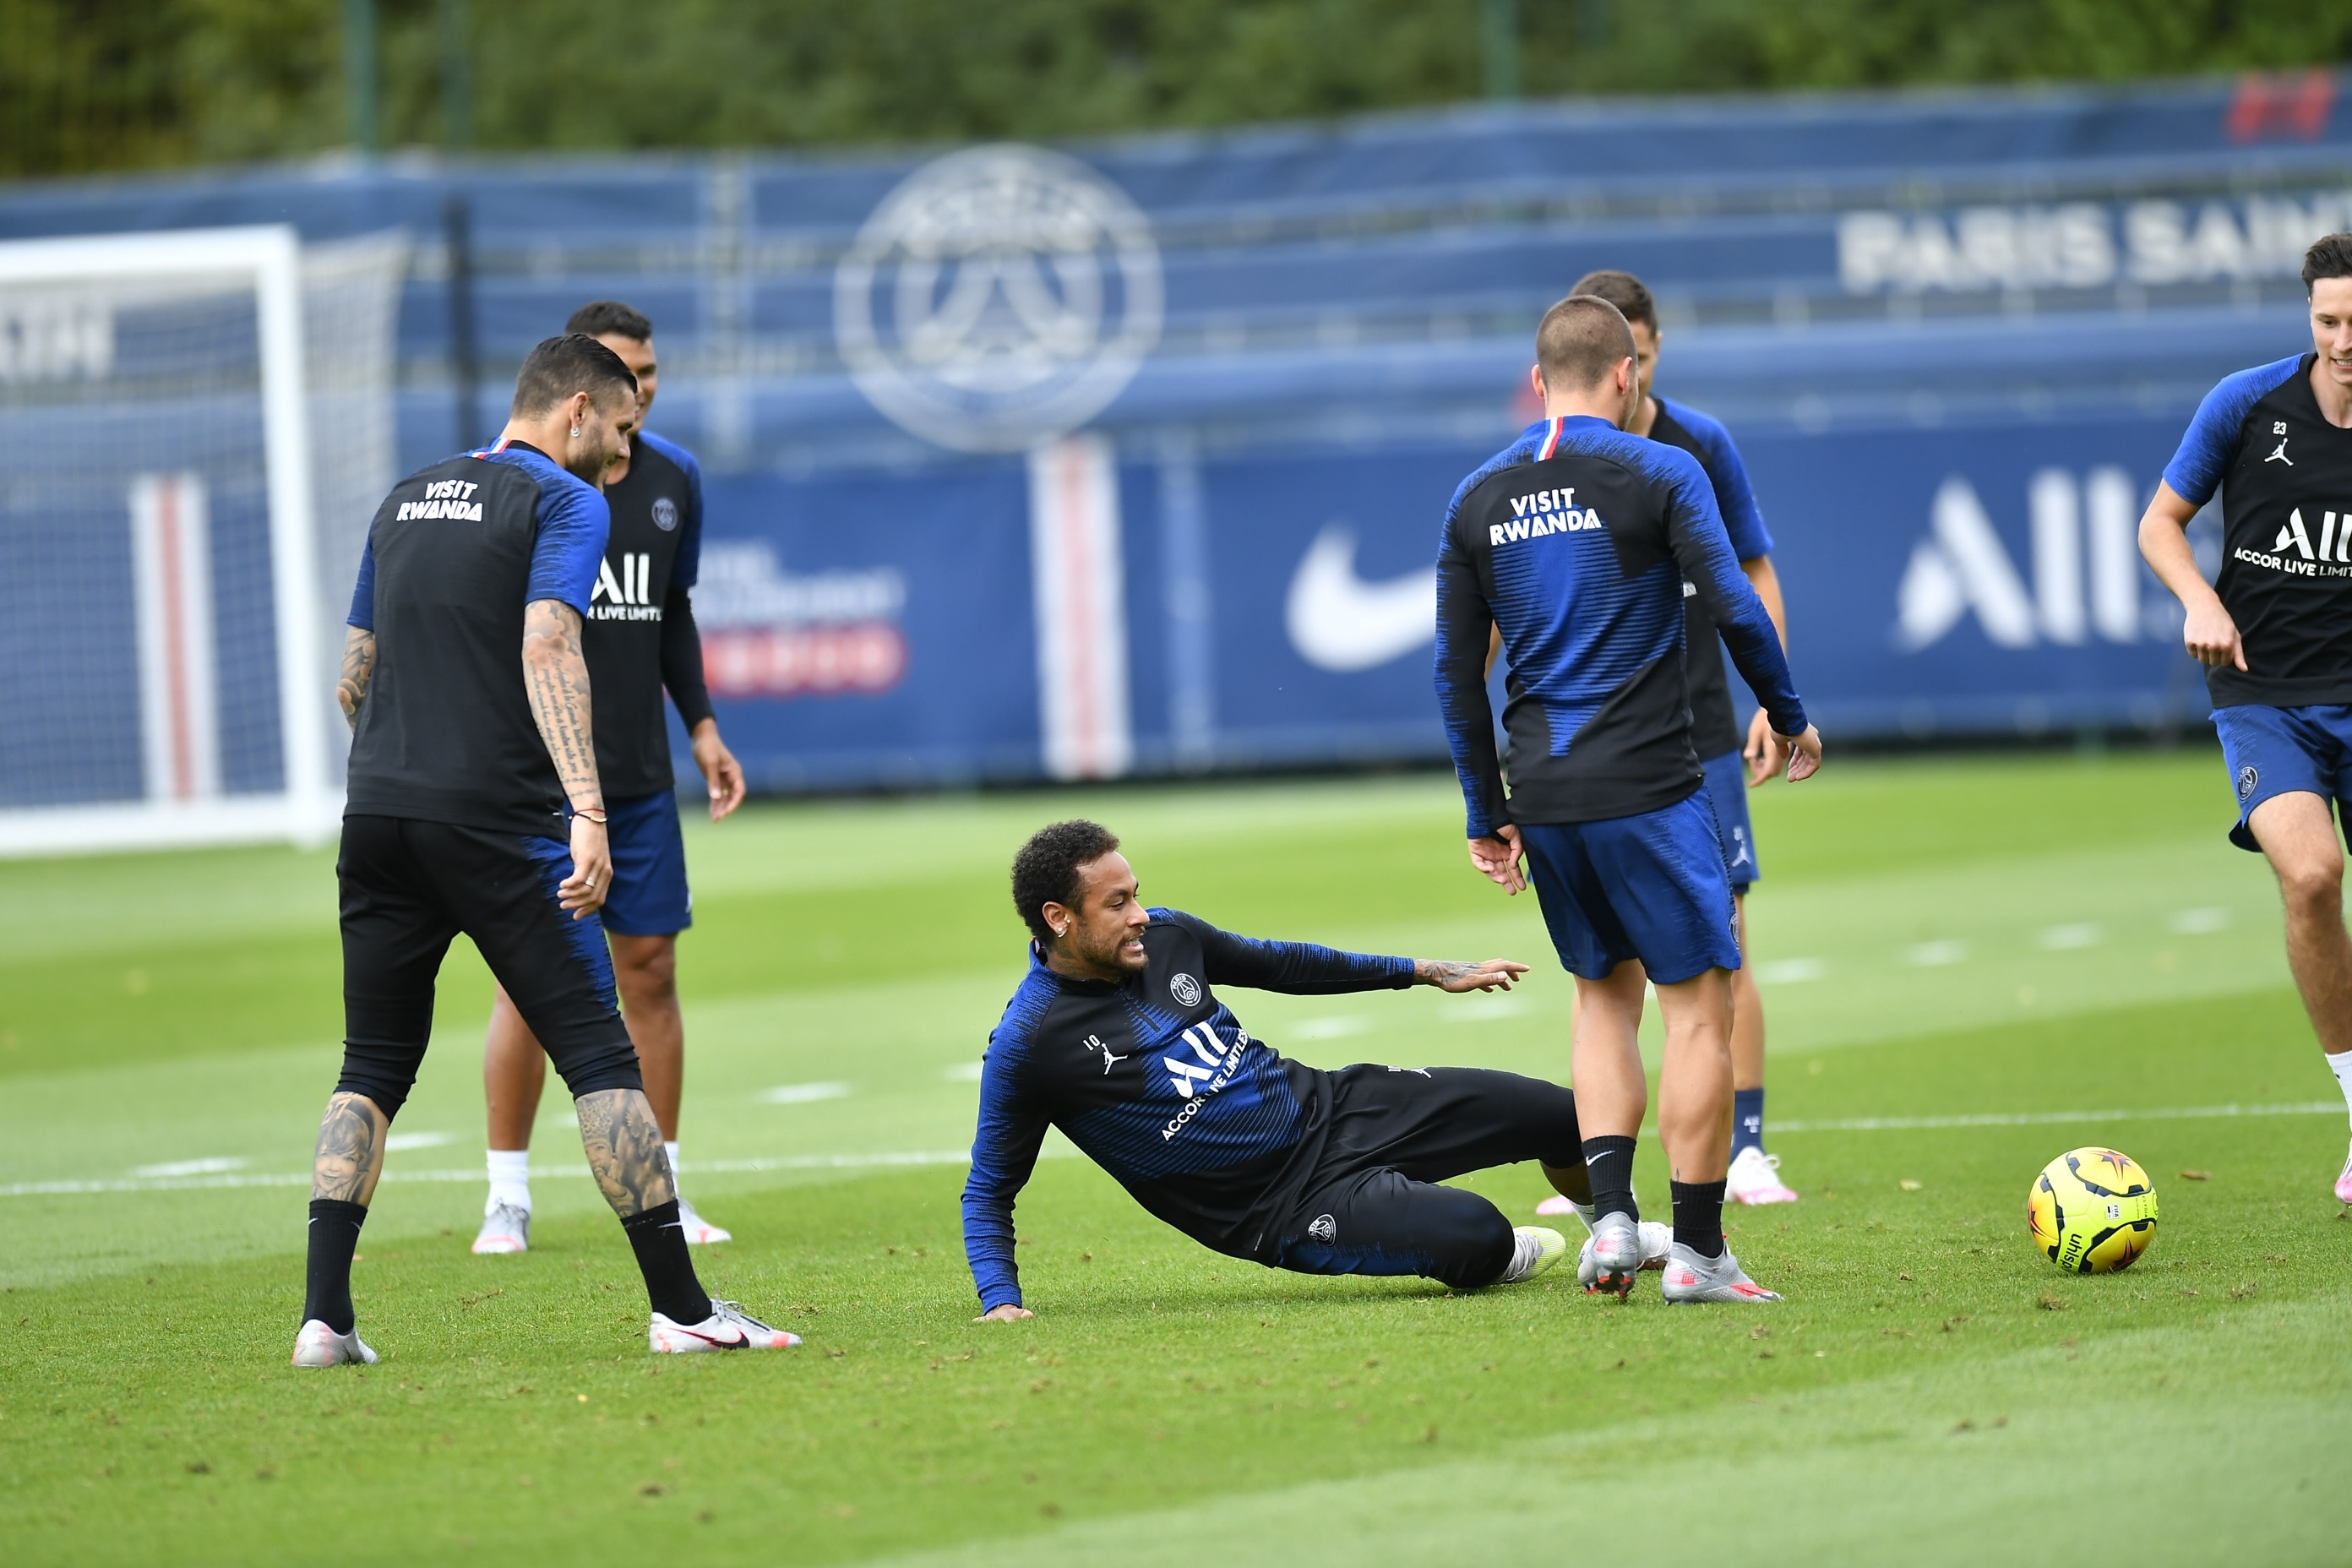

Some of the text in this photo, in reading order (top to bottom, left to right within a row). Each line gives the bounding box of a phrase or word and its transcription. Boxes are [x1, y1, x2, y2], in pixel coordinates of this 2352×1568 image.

[1839, 207, 2114, 295] PARIS
[2273, 421, 2287, 435] 23
[425, 479, 478, 500] VISIT
[1510, 487, 1575, 517] VISIT
[395, 499, 483, 522] RWANDA
[1489, 508, 1602, 546] RWANDA
[2234, 547, 2282, 571] ACCOR
[2284, 558, 2317, 576] LIVE
[1082, 1034, 1101, 1051] 10
[1162, 1096, 1206, 1141] ACCOR
